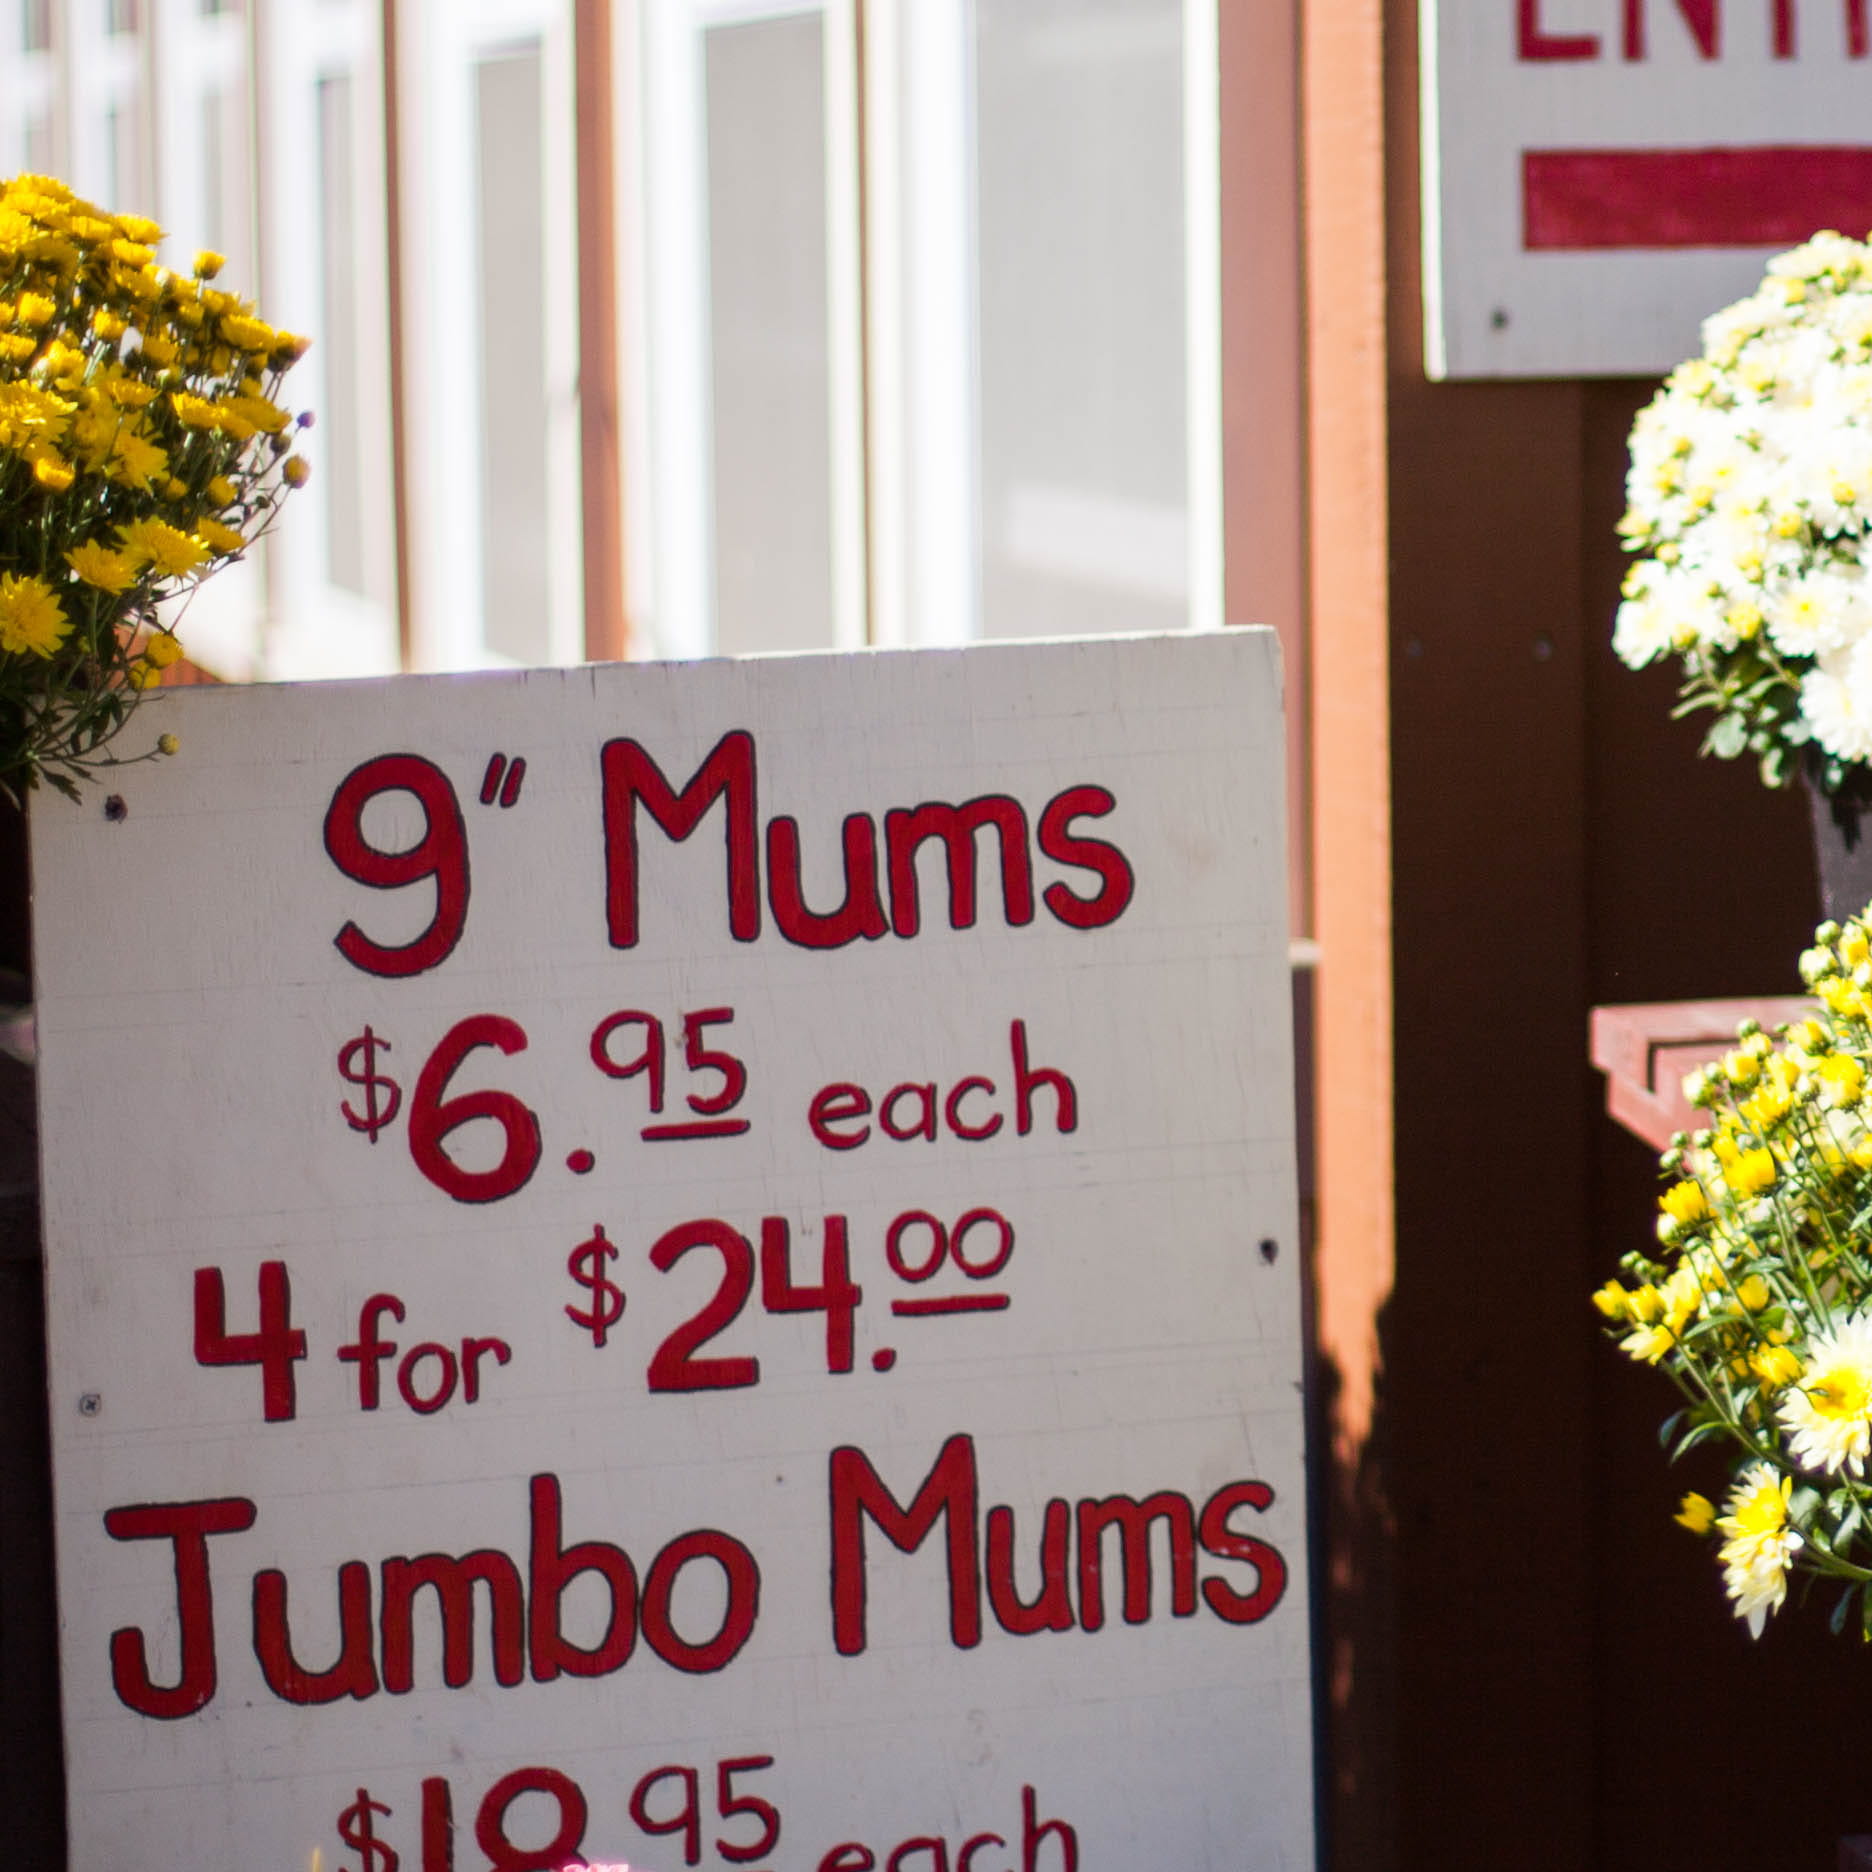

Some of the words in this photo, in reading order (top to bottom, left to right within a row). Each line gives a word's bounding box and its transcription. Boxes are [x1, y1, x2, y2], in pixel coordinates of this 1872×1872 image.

[324, 754, 525, 977] 9"
[600, 730, 1134, 950] Mums
[334, 1004, 751, 1203] $6.95
[805, 1016, 1078, 1151] each
[190, 1257, 308, 1423] 4
[334, 1290, 512, 1415] for
[562, 1205, 1015, 1394] $24.00
[103, 1472, 760, 1720] Jumbo
[829, 1433, 1288, 1657] Mums
